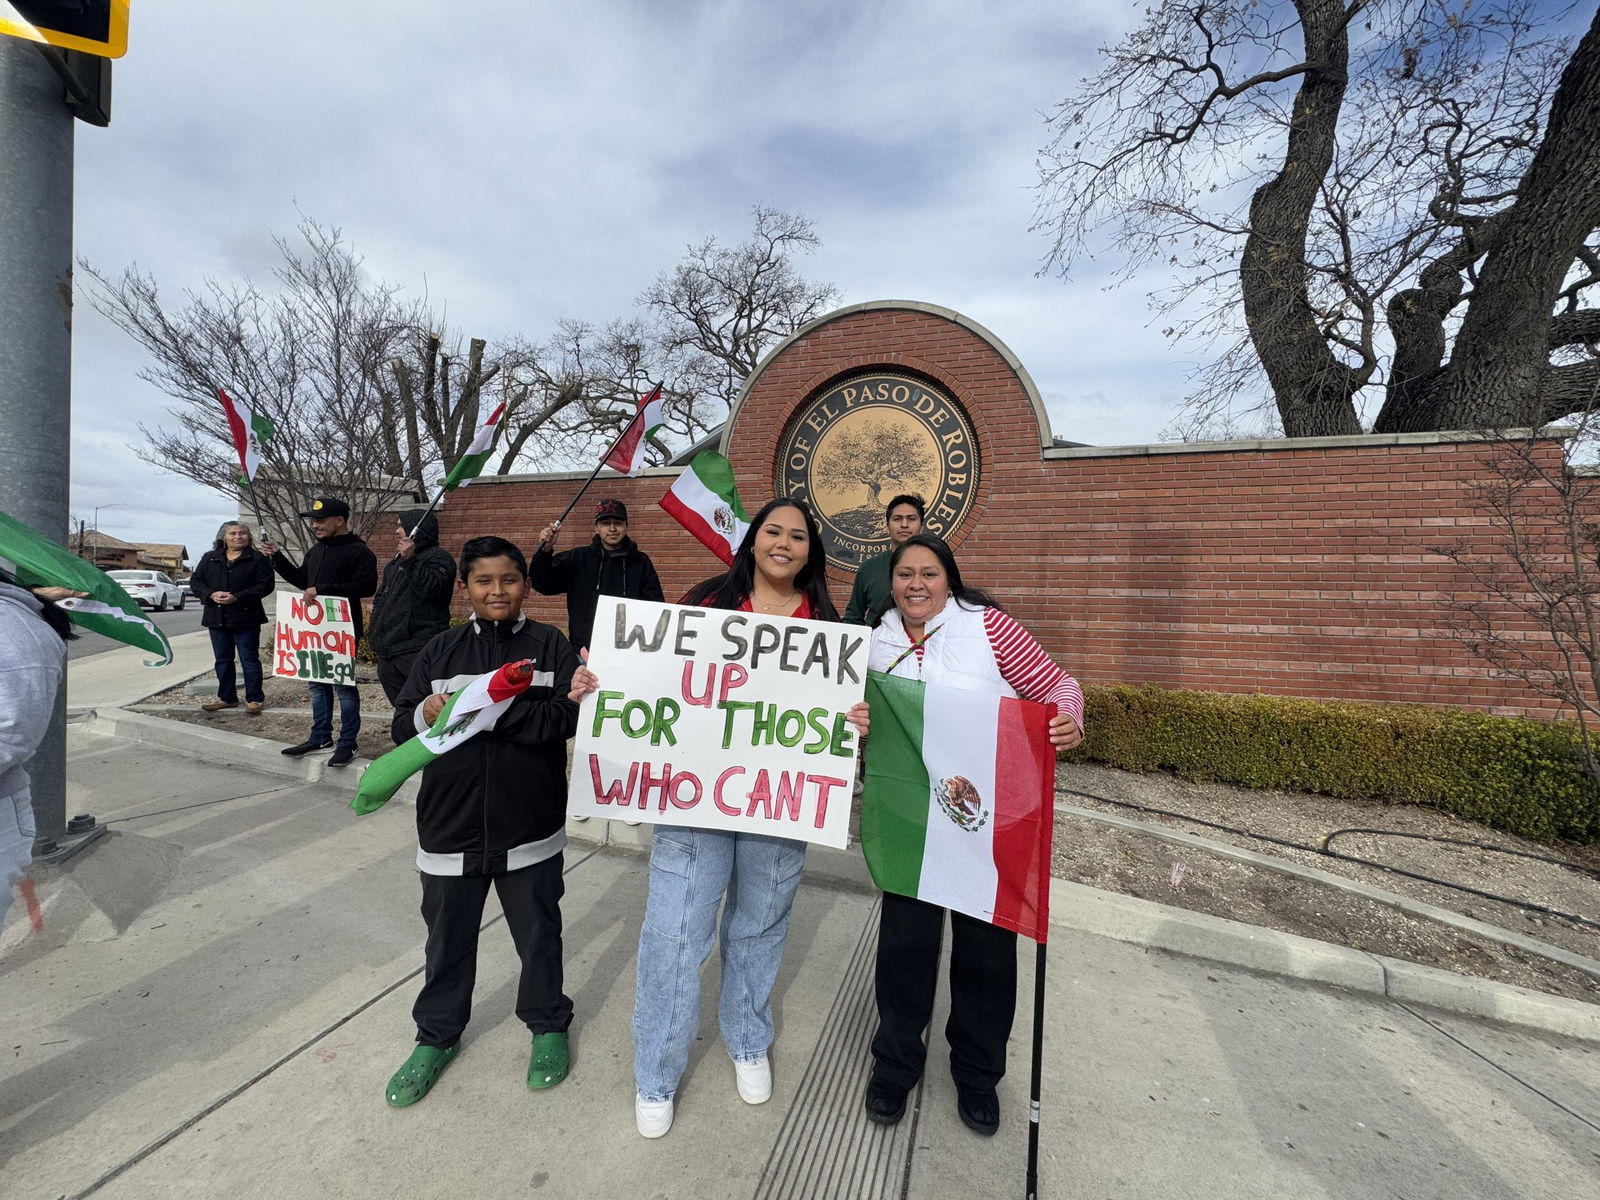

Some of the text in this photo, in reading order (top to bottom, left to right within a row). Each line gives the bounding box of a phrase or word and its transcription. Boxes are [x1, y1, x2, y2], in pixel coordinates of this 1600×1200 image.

[790, 383, 967, 536] OF EL PASO DE ROBLES
[833, 535, 892, 553] INCORPOR
[291, 596, 324, 625] NO
[275, 650, 297, 676] IS
[277, 621, 356, 658] Human
[614, 603, 864, 685] WE SPEAK
[681, 660, 748, 708] UP
[591, 690, 854, 758] FOR THOSE
[588, 753, 848, 829] WHO CANT
